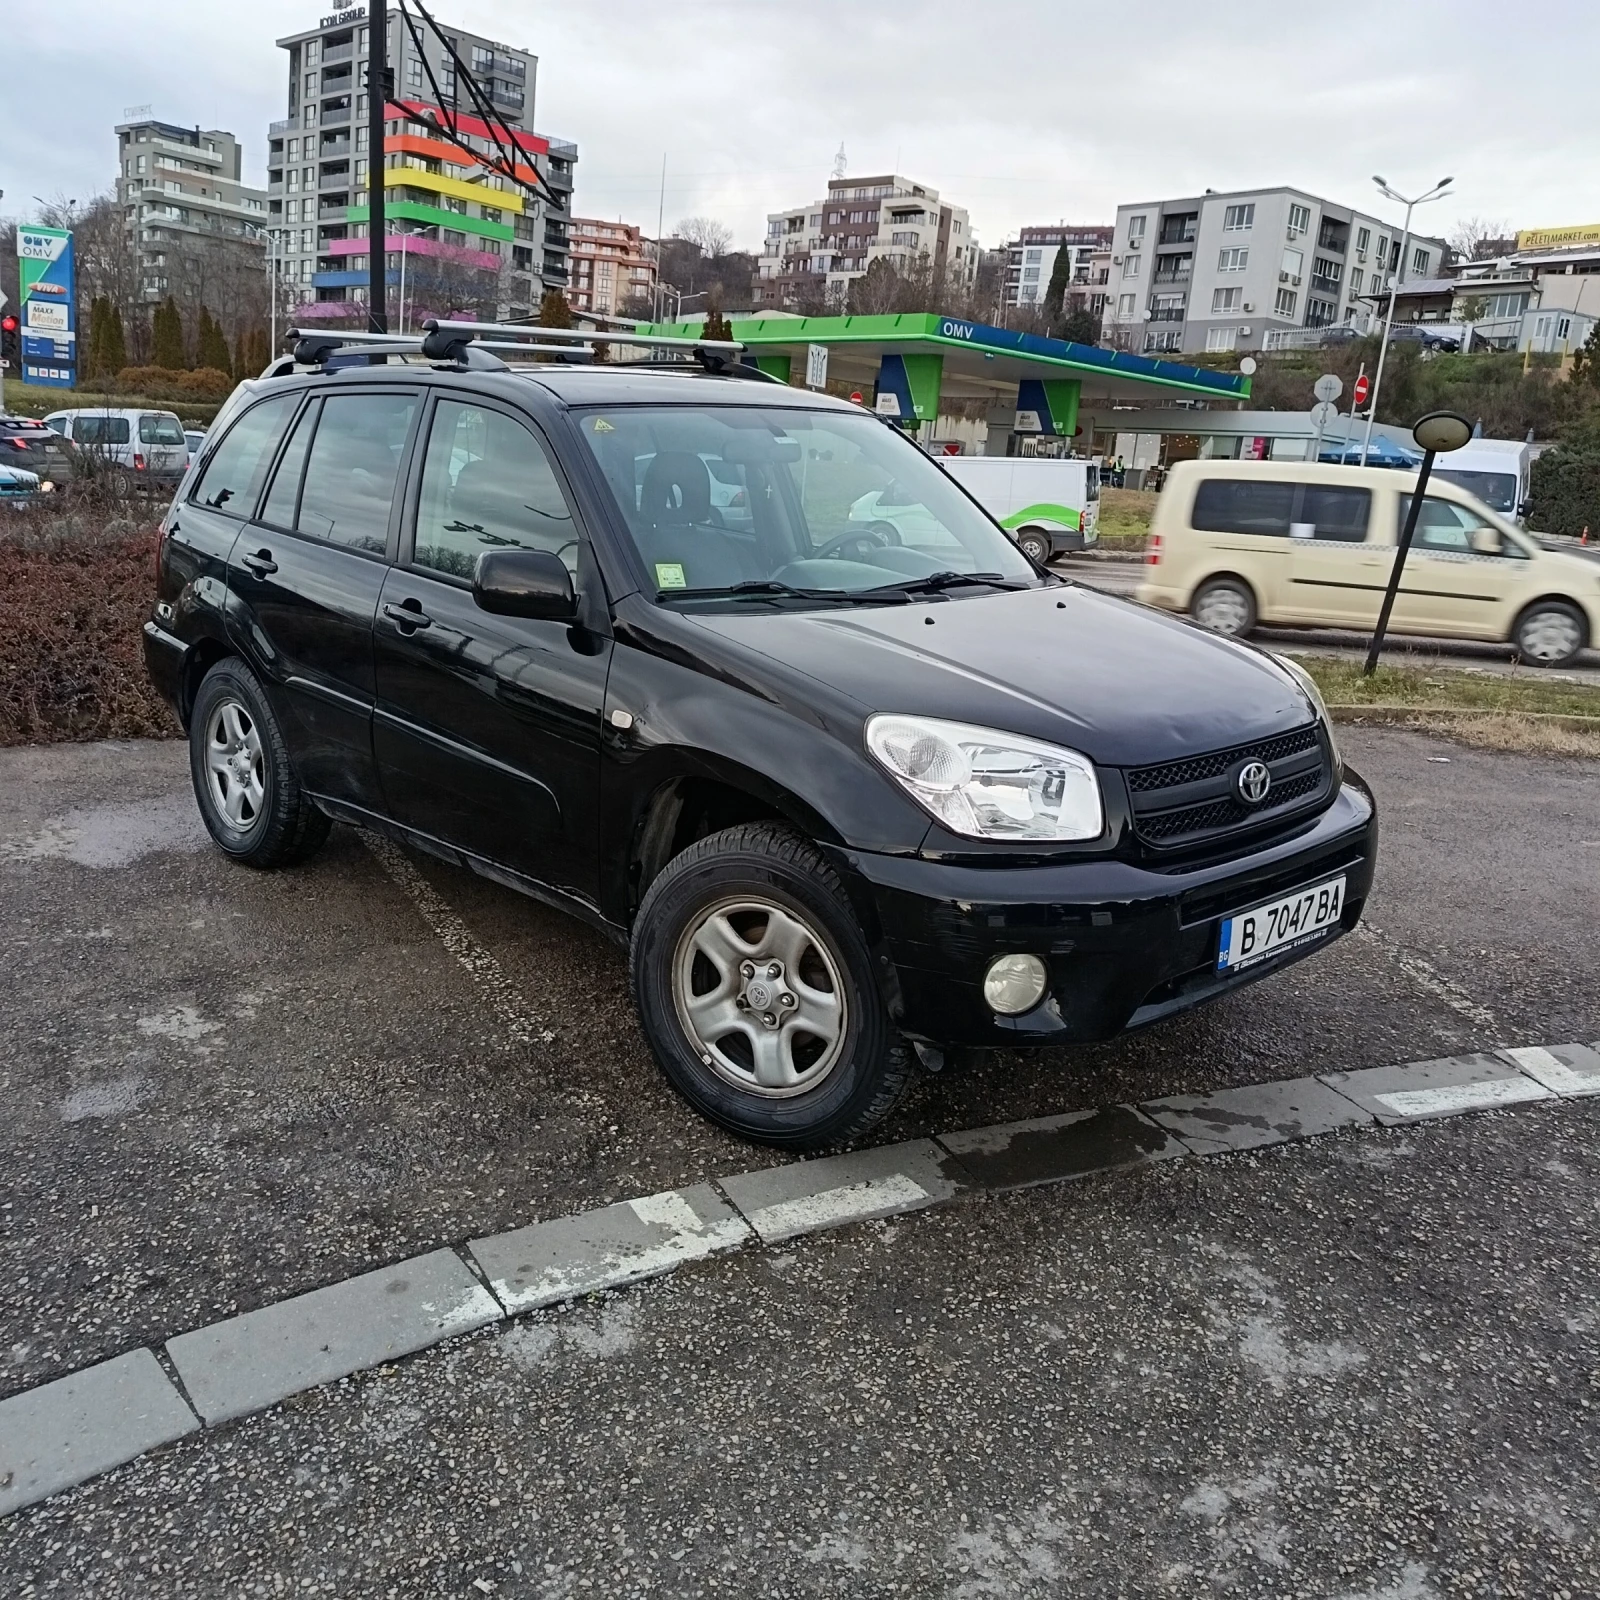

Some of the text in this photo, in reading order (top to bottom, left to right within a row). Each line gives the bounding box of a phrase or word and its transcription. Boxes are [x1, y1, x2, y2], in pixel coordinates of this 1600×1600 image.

[339, 7, 365, 23] GROUP
[23, 246, 52, 257] OMV
[37, 284, 58, 293] VIVA
[33, 306, 54, 314] MAXX
[31, 313, 64, 325] Motion
[943, 321, 974, 339] OMV
[1241, 917, 1256, 956] B
[1265, 893, 1315, 946] 7047
[1315, 884, 1339, 924] BA
[1218, 950, 1229, 963] BG
